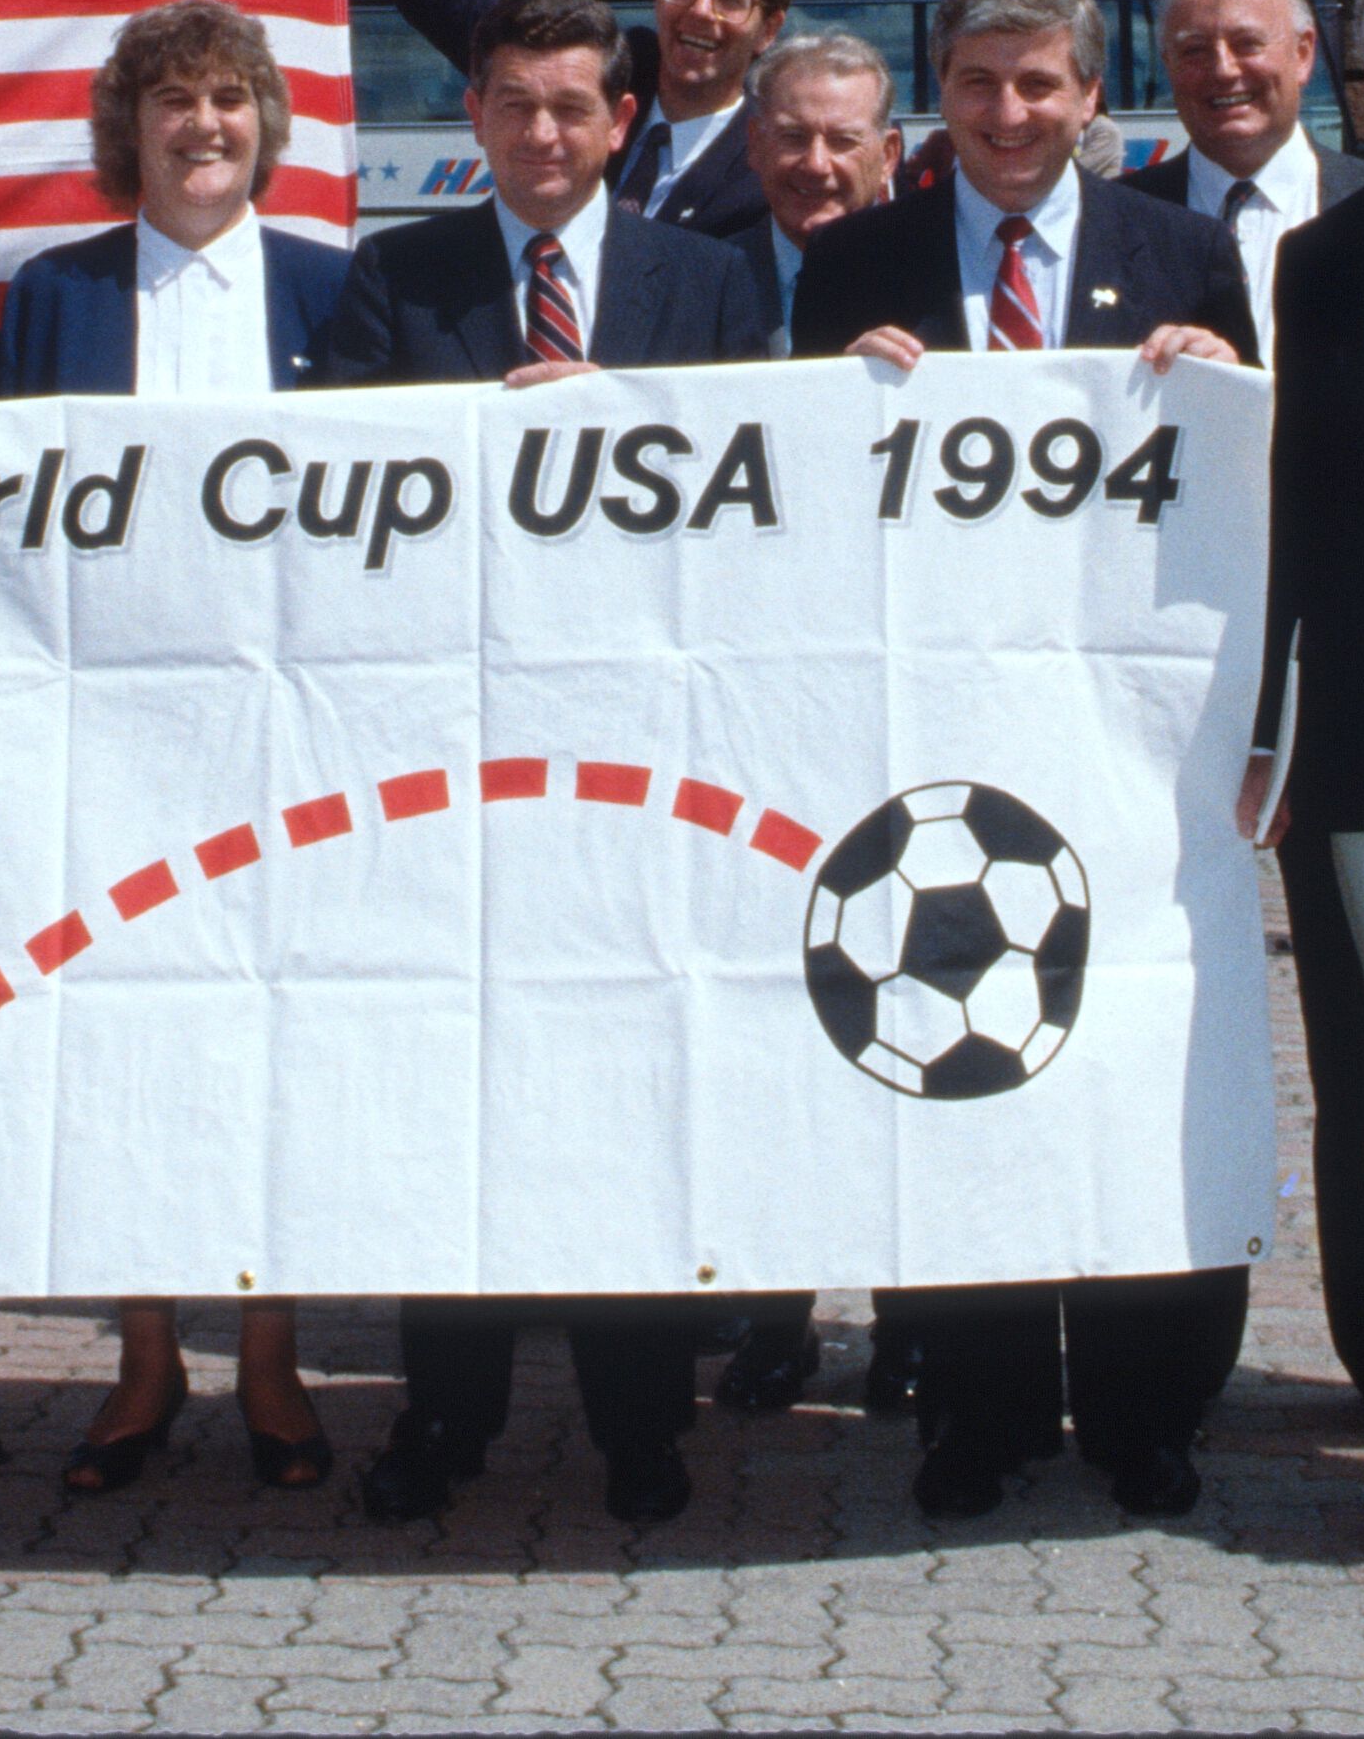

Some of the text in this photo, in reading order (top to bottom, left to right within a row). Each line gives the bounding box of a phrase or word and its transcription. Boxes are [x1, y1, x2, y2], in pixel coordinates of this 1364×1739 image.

[201, 439, 452, 570] Cup
[508, 423, 779, 536] USA
[871, 418, 1182, 524] 1994
